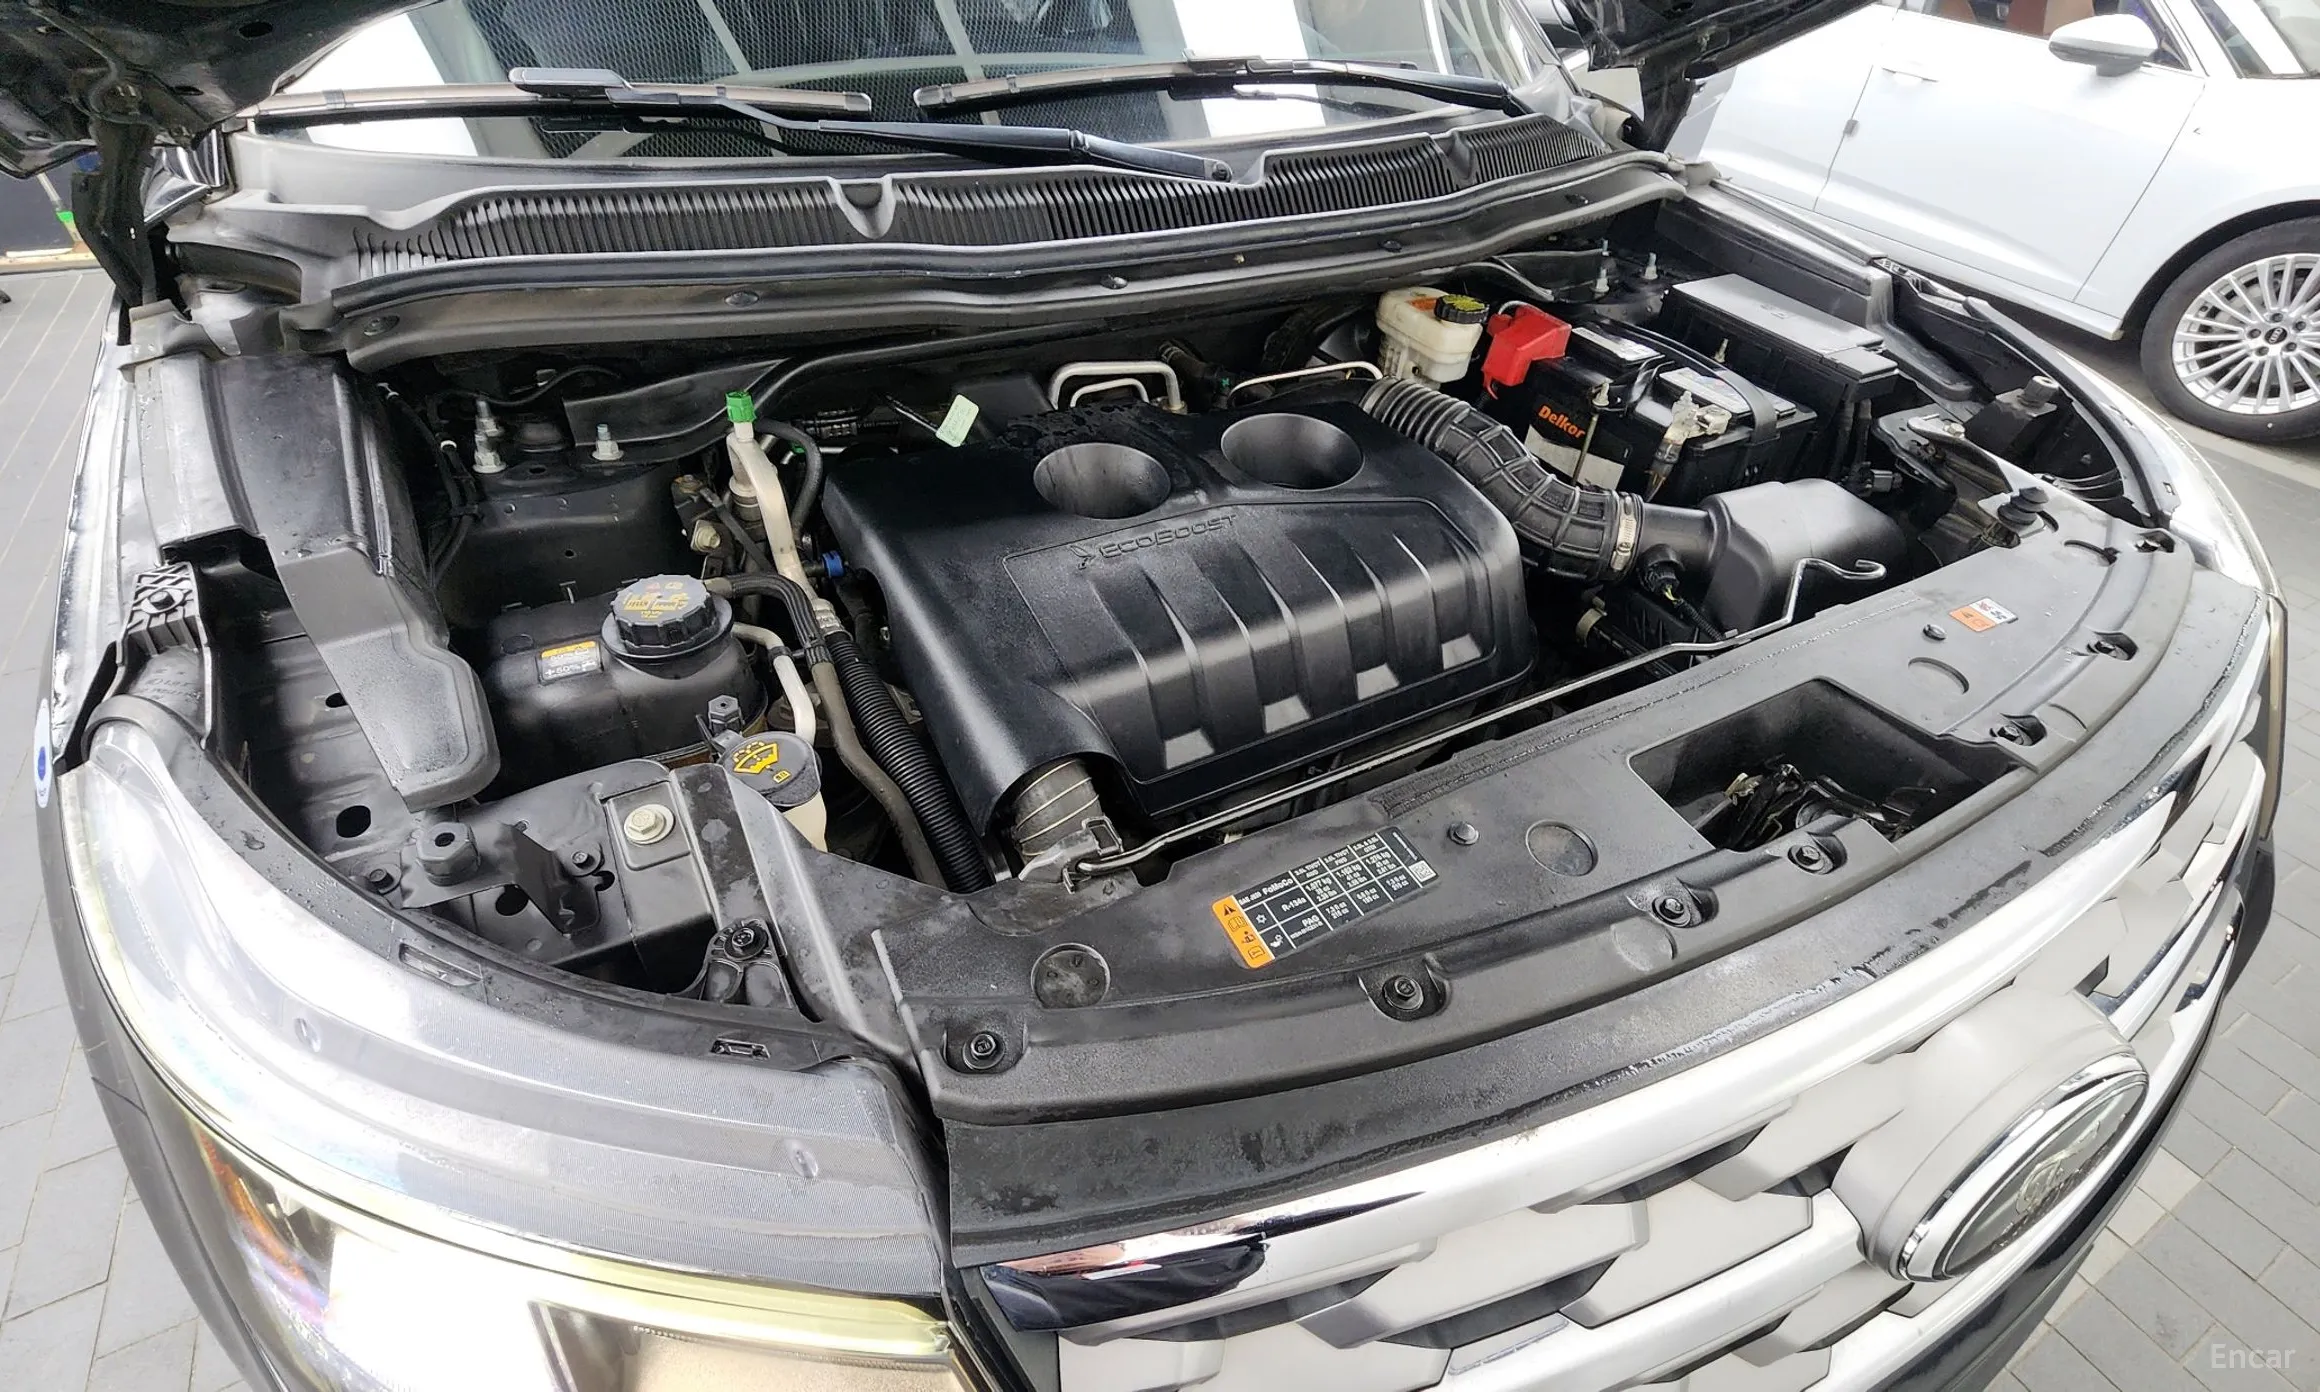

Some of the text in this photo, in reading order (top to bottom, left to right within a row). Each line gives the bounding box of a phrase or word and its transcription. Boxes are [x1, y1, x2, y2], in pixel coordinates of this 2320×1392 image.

[1538, 405, 1586, 438] Delkor
[1262, 878, 1293, 895] FoMoCo
[1281, 898, 1307, 911] R-134a
